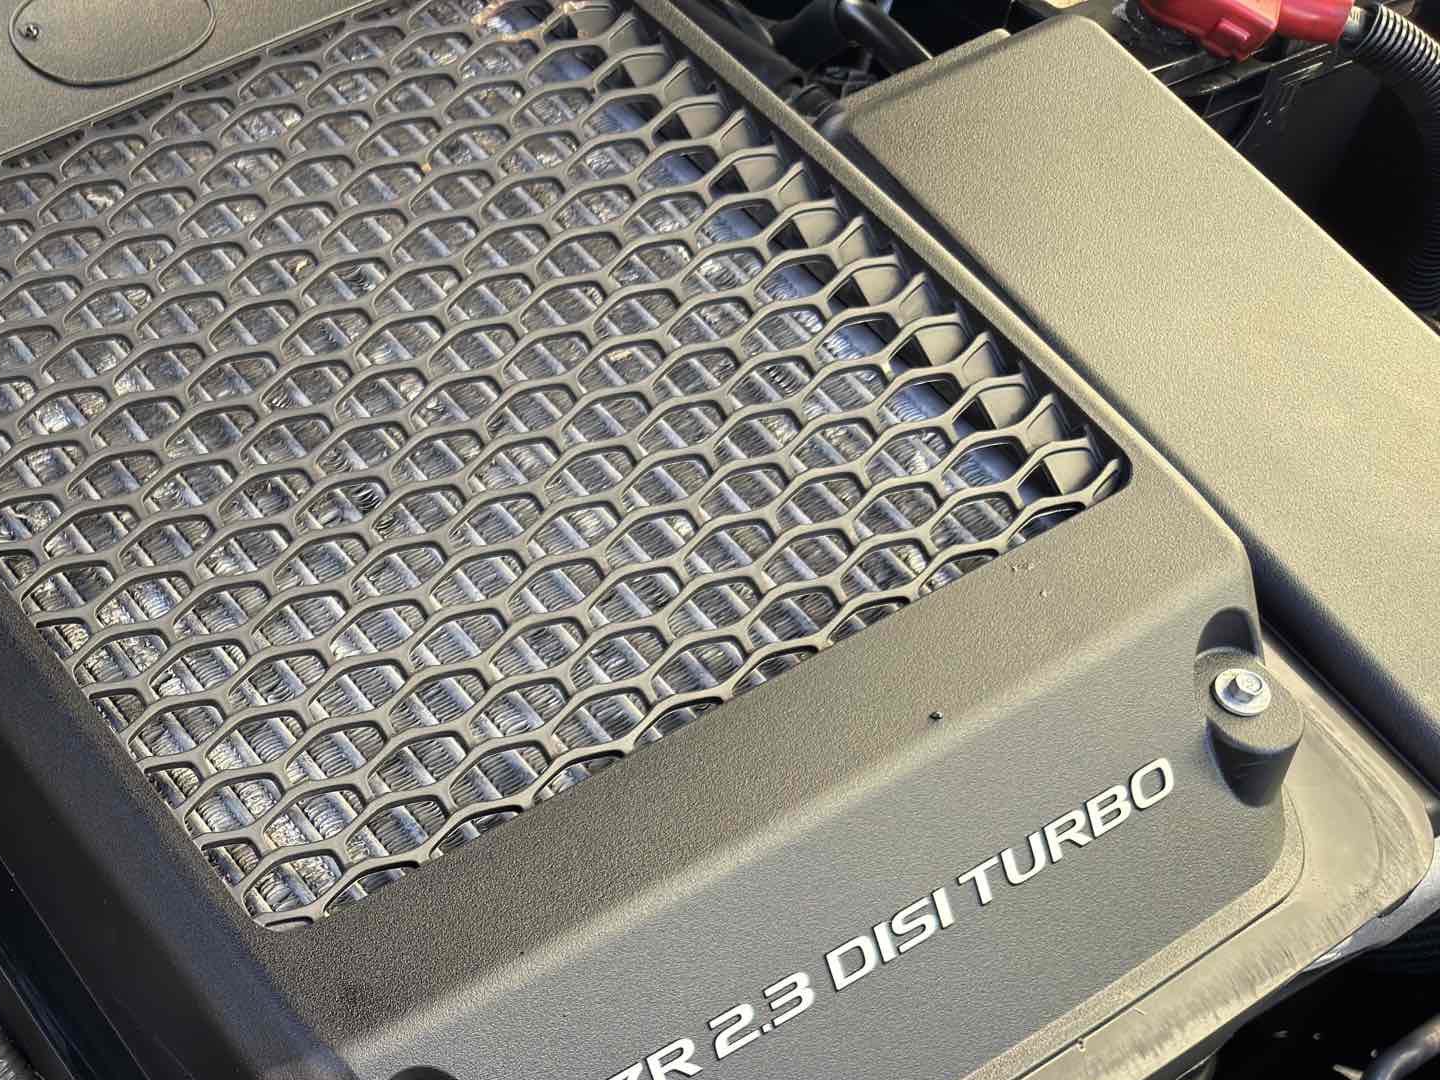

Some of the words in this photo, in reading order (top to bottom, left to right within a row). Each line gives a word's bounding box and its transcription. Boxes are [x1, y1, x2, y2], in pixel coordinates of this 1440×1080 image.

[706, 971, 816, 1060] 2.3
[824, 887, 956, 992] DISI
[956, 757, 1175, 906] TURBO
